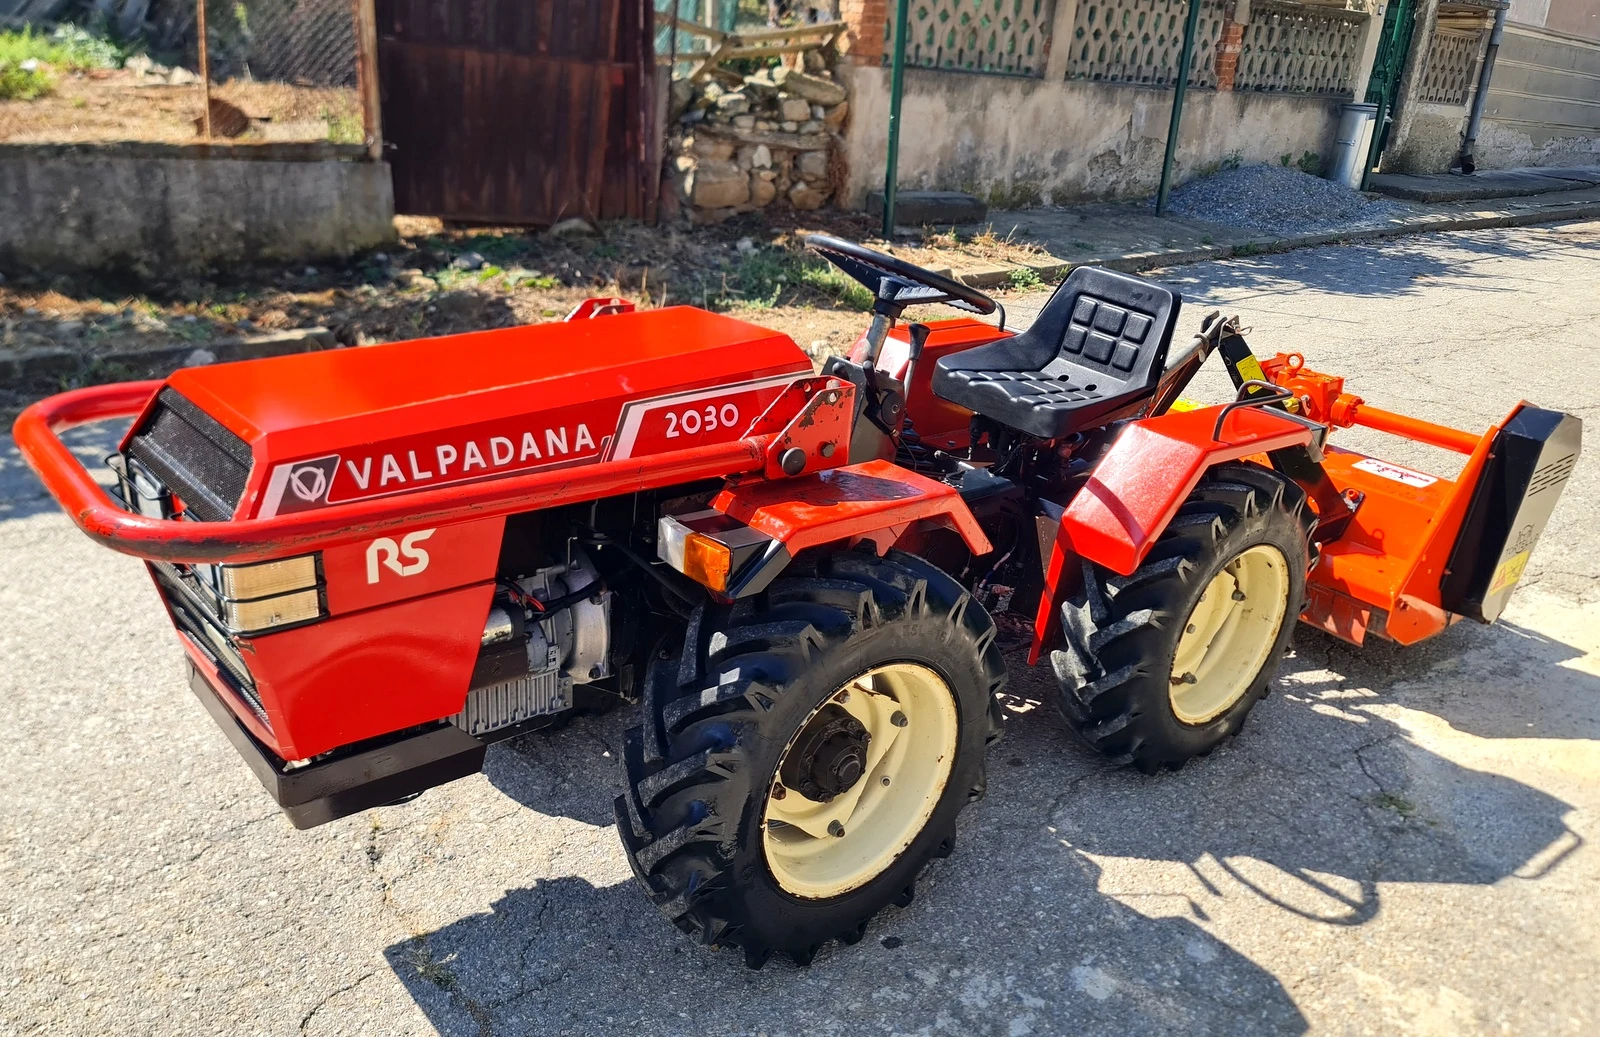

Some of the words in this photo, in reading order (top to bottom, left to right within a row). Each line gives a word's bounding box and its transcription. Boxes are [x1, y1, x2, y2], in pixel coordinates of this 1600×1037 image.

[665, 403, 739, 438] 2030
[346, 424, 596, 490] VALPADANA
[366, 528, 437, 585] RS
